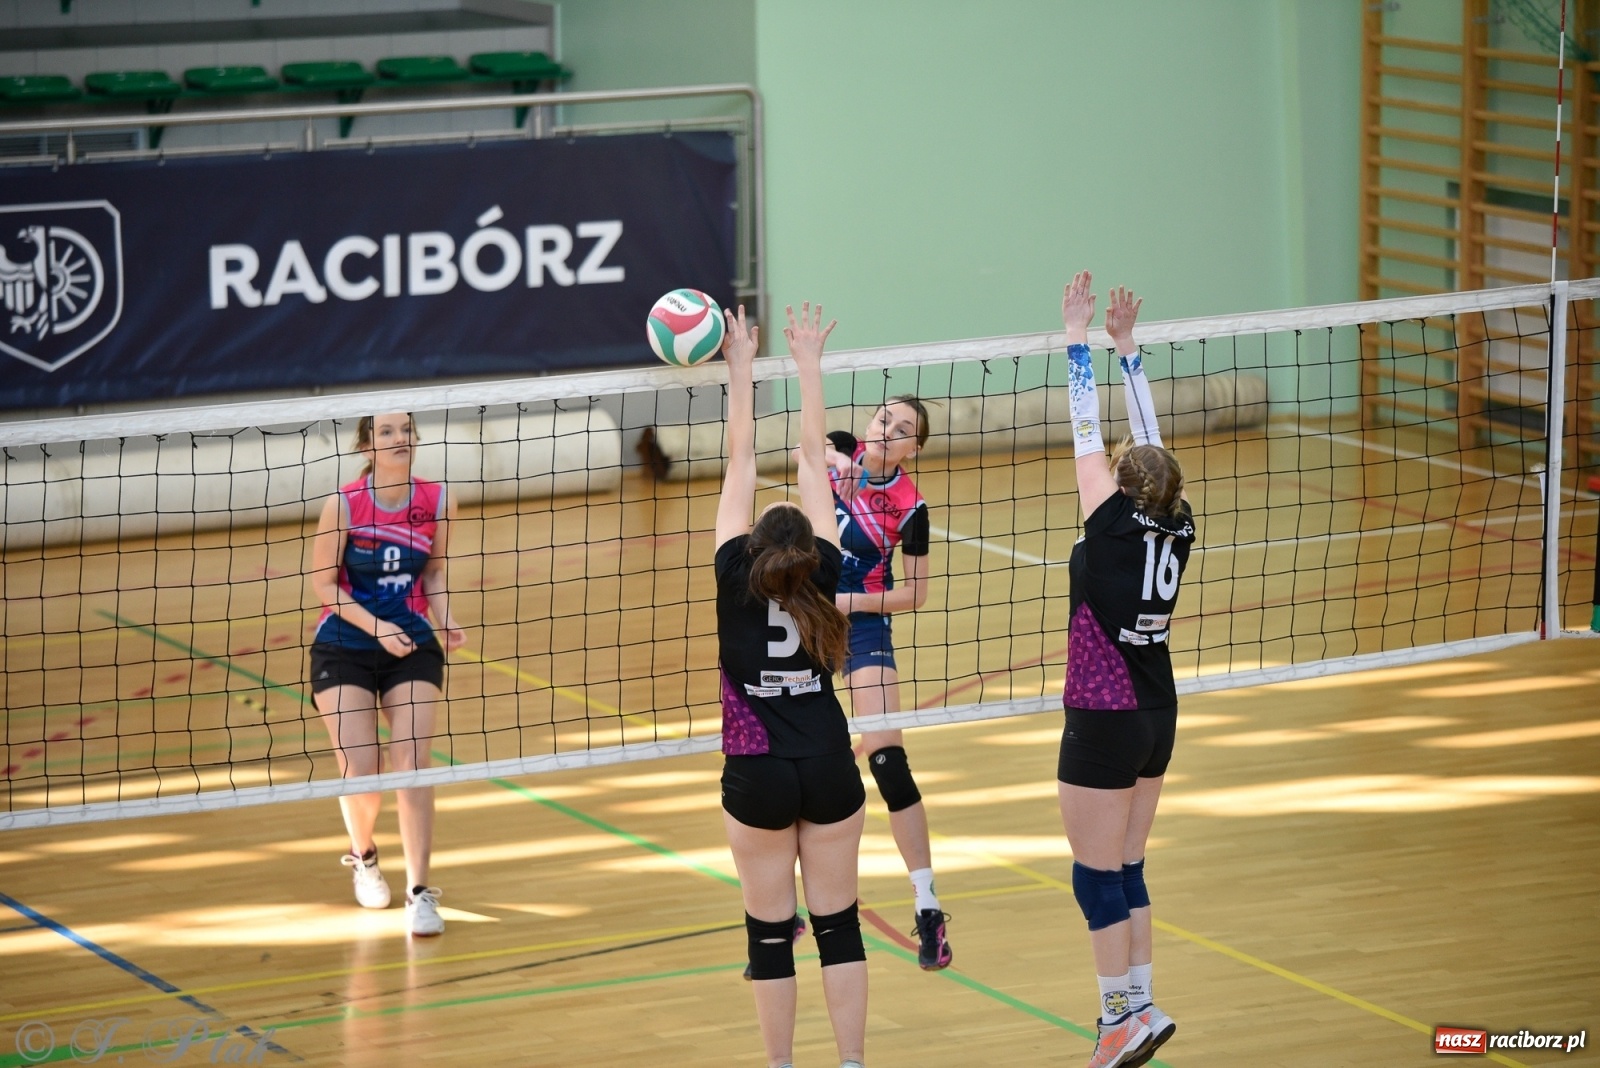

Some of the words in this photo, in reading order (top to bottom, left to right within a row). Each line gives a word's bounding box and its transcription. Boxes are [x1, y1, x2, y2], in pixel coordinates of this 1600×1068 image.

[208, 205, 626, 310] RACIBÓRZ
[382, 546, 401, 572] 8
[1141, 530, 1180, 601] 16
[767, 598, 801, 658] 5
[784, 674, 811, 683] Technik
